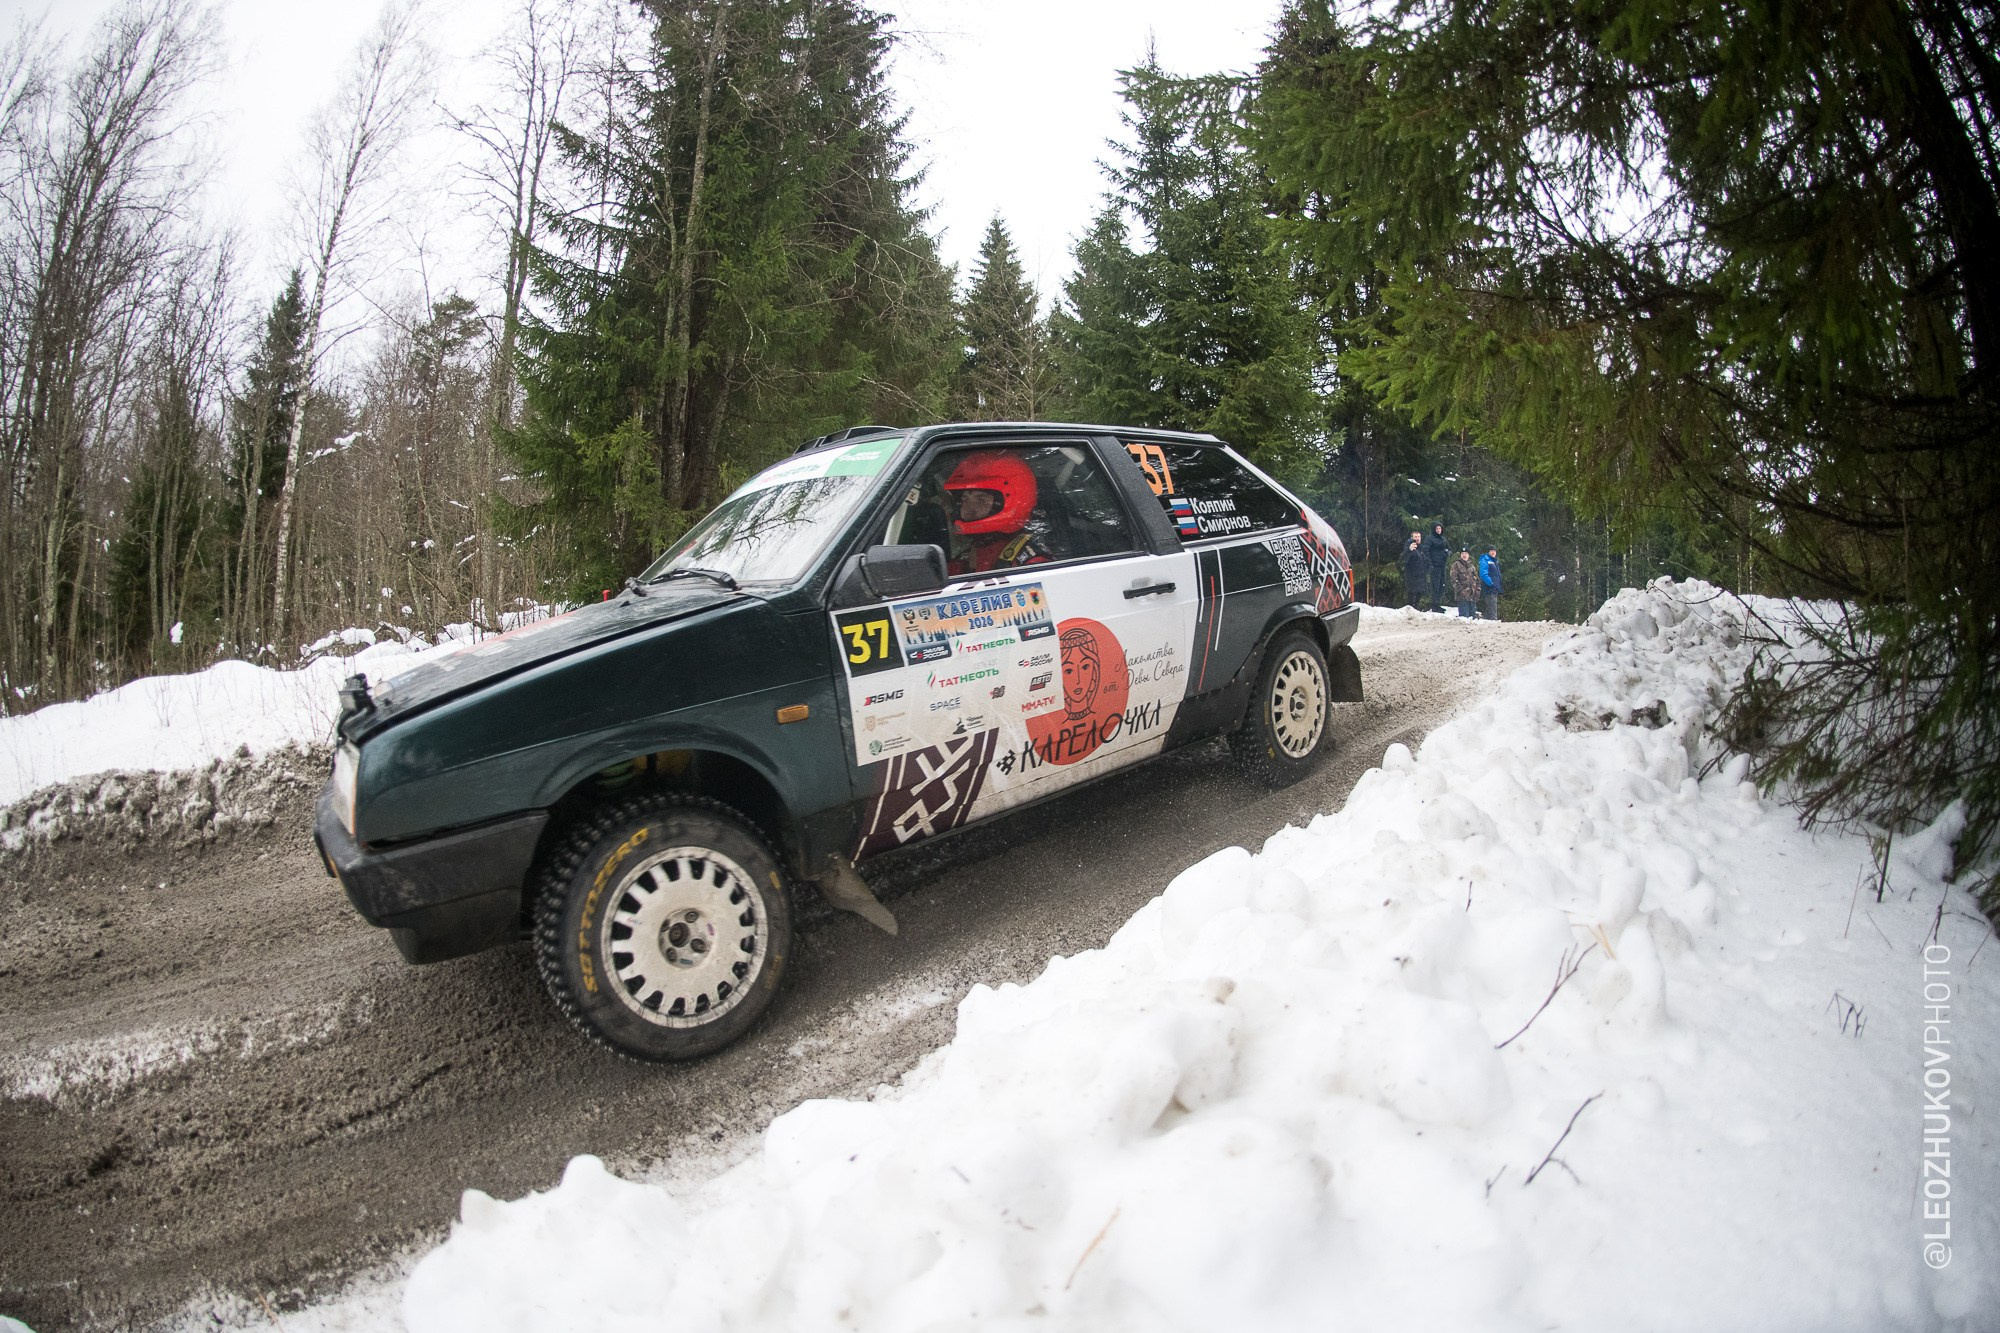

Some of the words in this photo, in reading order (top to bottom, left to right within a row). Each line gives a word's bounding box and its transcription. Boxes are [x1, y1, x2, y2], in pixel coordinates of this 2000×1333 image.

[1126, 443, 1175, 496] 37
[1188, 497, 1237, 515] Колпин
[1197, 515, 1252, 535] Смирнов
[936, 593, 1013, 620] КАРЕЛИЯ
[841, 619, 890, 664] 37
[965, 638, 1016, 654] ТАТНЕФТЬ
[1114, 642, 1175, 673] Лакомства
[938, 668, 1000, 688] ТАТНЕФТЬ
[1103, 681, 1119, 695] от
[1122, 669, 1151, 691] Девы
[1153, 660, 1186, 682] Севера
[867, 689, 904, 706] RSMG
[929, 697, 961, 712] SPACE
[1020, 699, 1162, 773] КАРЕЛОЧКА
